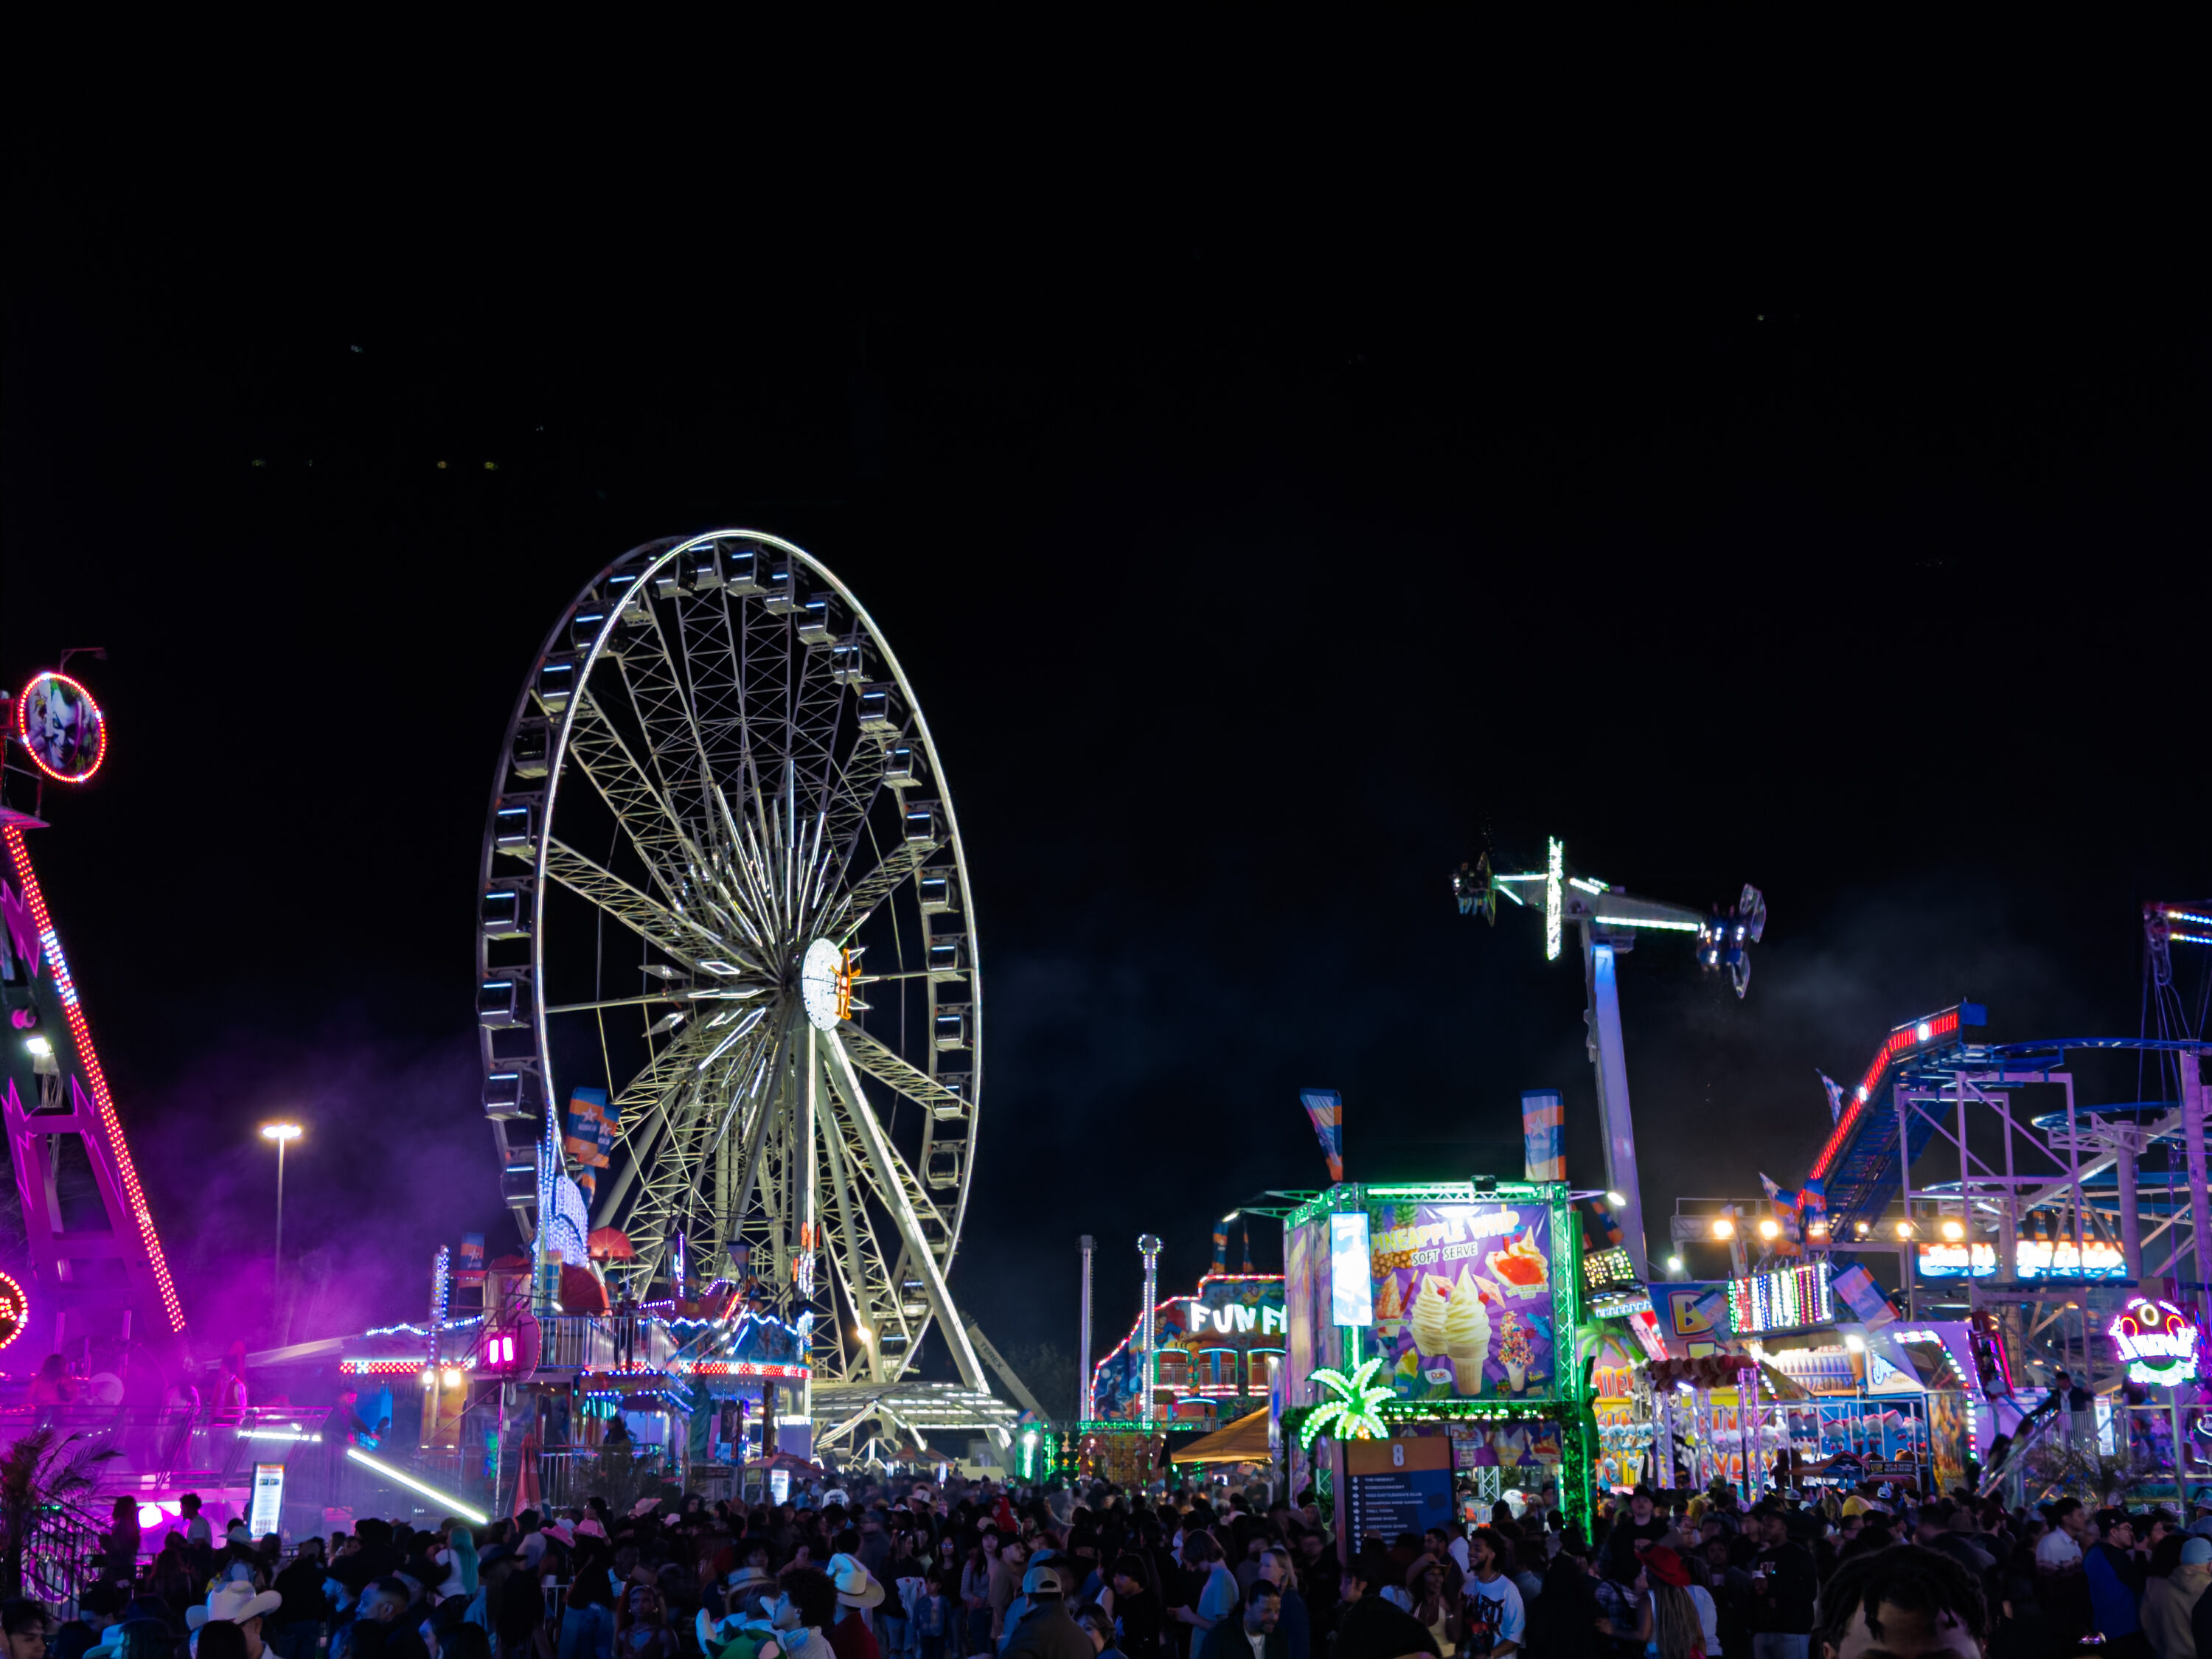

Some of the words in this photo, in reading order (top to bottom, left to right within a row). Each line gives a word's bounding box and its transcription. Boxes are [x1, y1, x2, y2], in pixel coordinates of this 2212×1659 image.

[1370, 1220, 1466, 1254] PINEAPPLE
[1467, 1211, 1520, 1239] WHIP
[1412, 1249, 1440, 1265] SOFT
[1443, 1242, 1478, 1260] SERVE
[1190, 1302, 1256, 1333] FUN
[981, 1342, 1003, 1369] TEREX
[1393, 1444, 1404, 1467] 8
